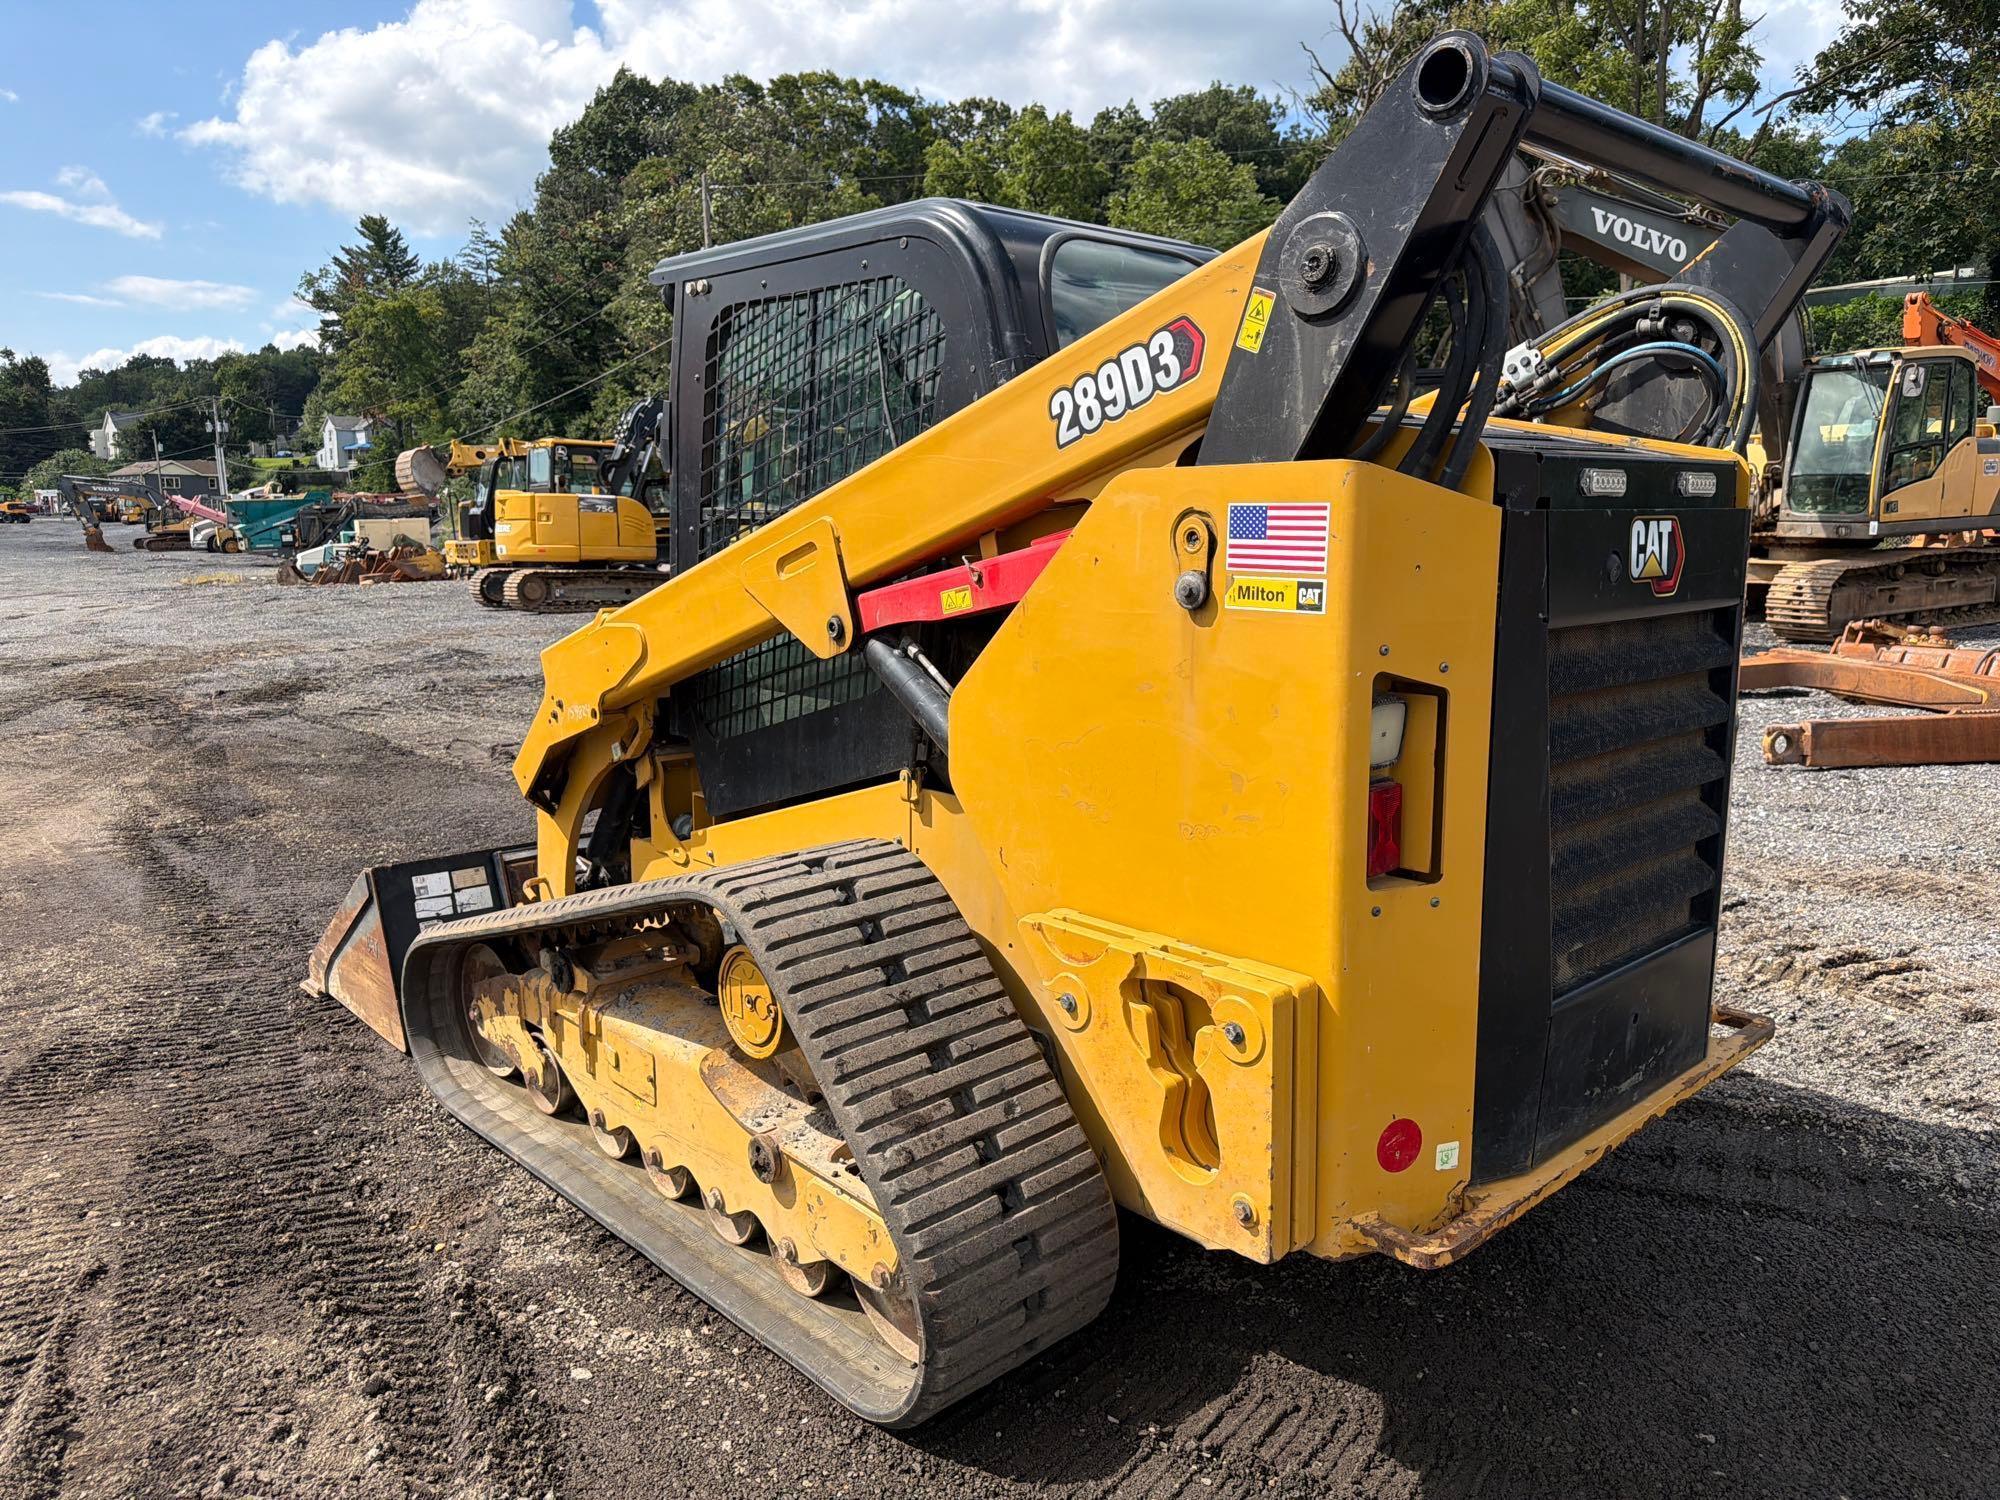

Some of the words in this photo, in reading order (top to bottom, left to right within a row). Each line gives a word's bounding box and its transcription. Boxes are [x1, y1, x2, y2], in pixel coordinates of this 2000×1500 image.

[1590, 206, 1687, 262] VOLVO
[1051, 330, 1181, 446] 289D3
[1630, 520, 1673, 579] CAT
[1237, 585, 1285, 603] Milton
[1299, 587, 1323, 605] CAT
